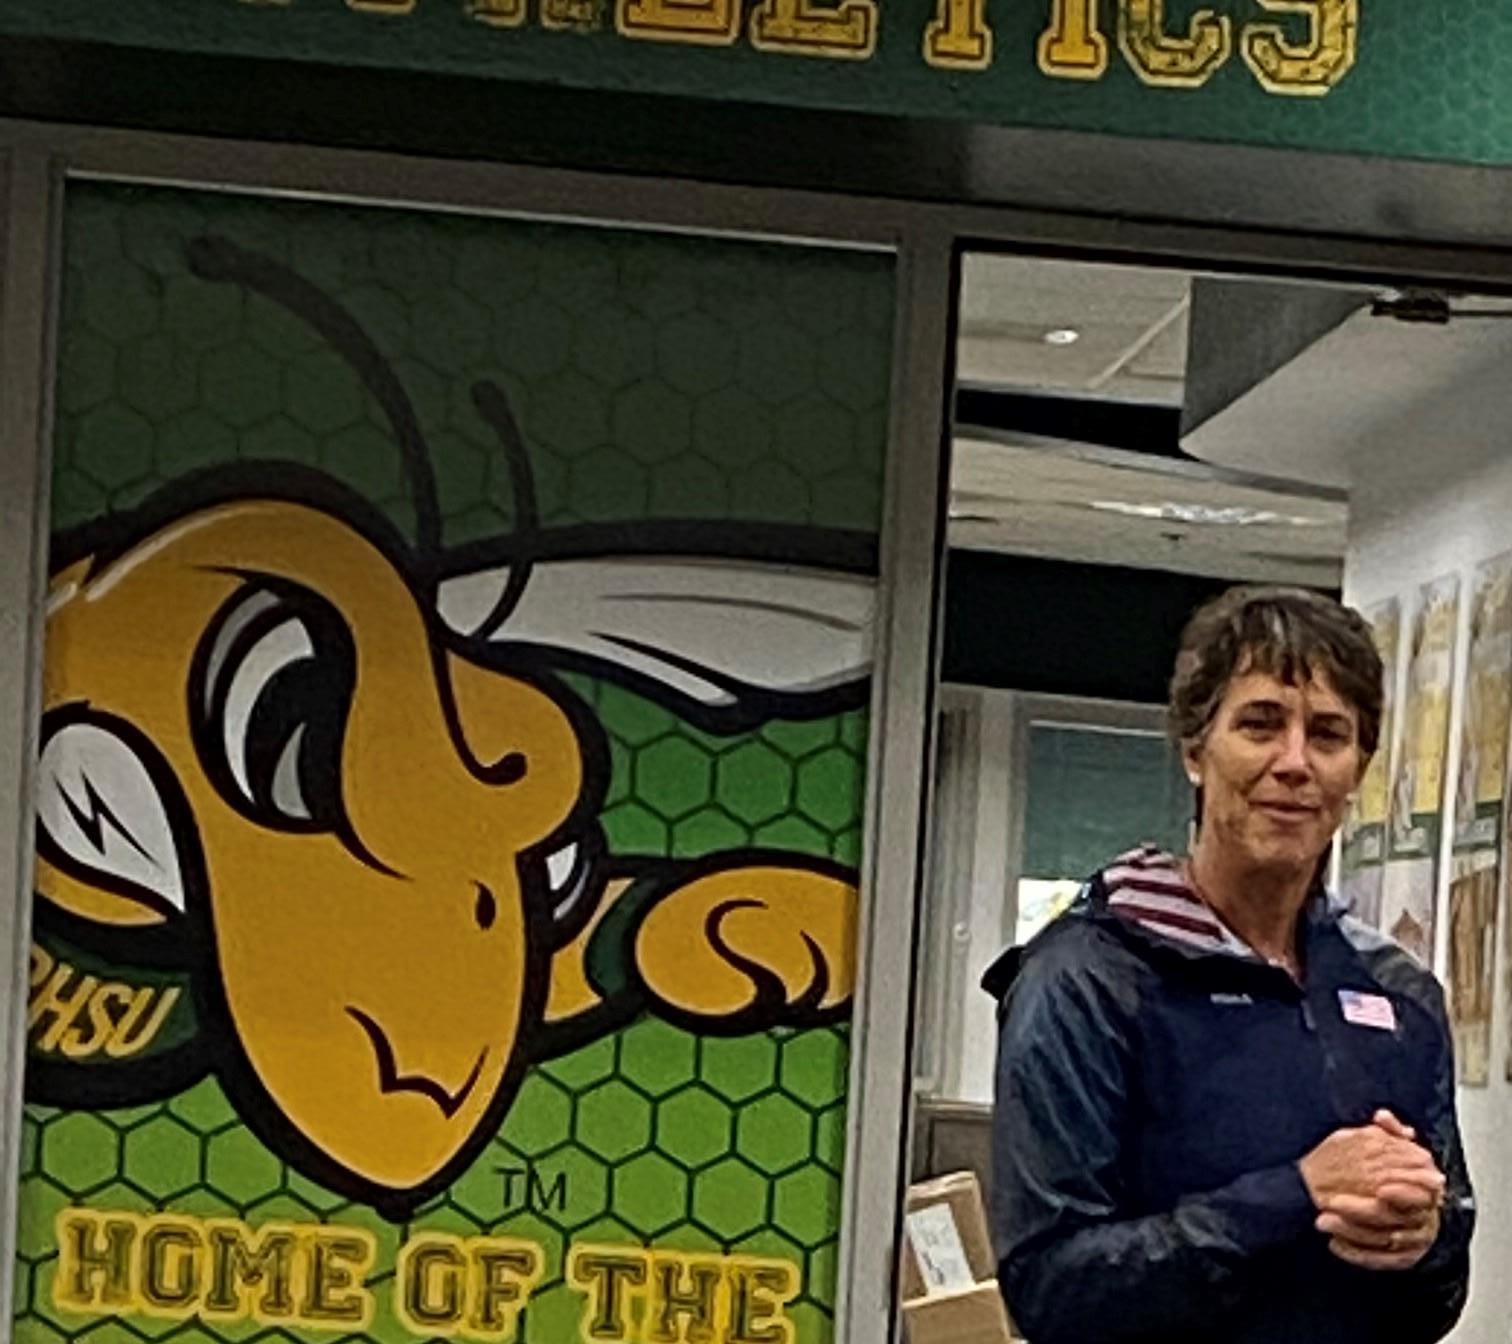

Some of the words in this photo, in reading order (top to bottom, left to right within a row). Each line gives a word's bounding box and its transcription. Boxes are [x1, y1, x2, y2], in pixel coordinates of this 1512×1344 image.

[491, 1167, 567, 1212] TM
[60, 1213, 372, 1326] HOME
[402, 1240, 541, 1337] OF
